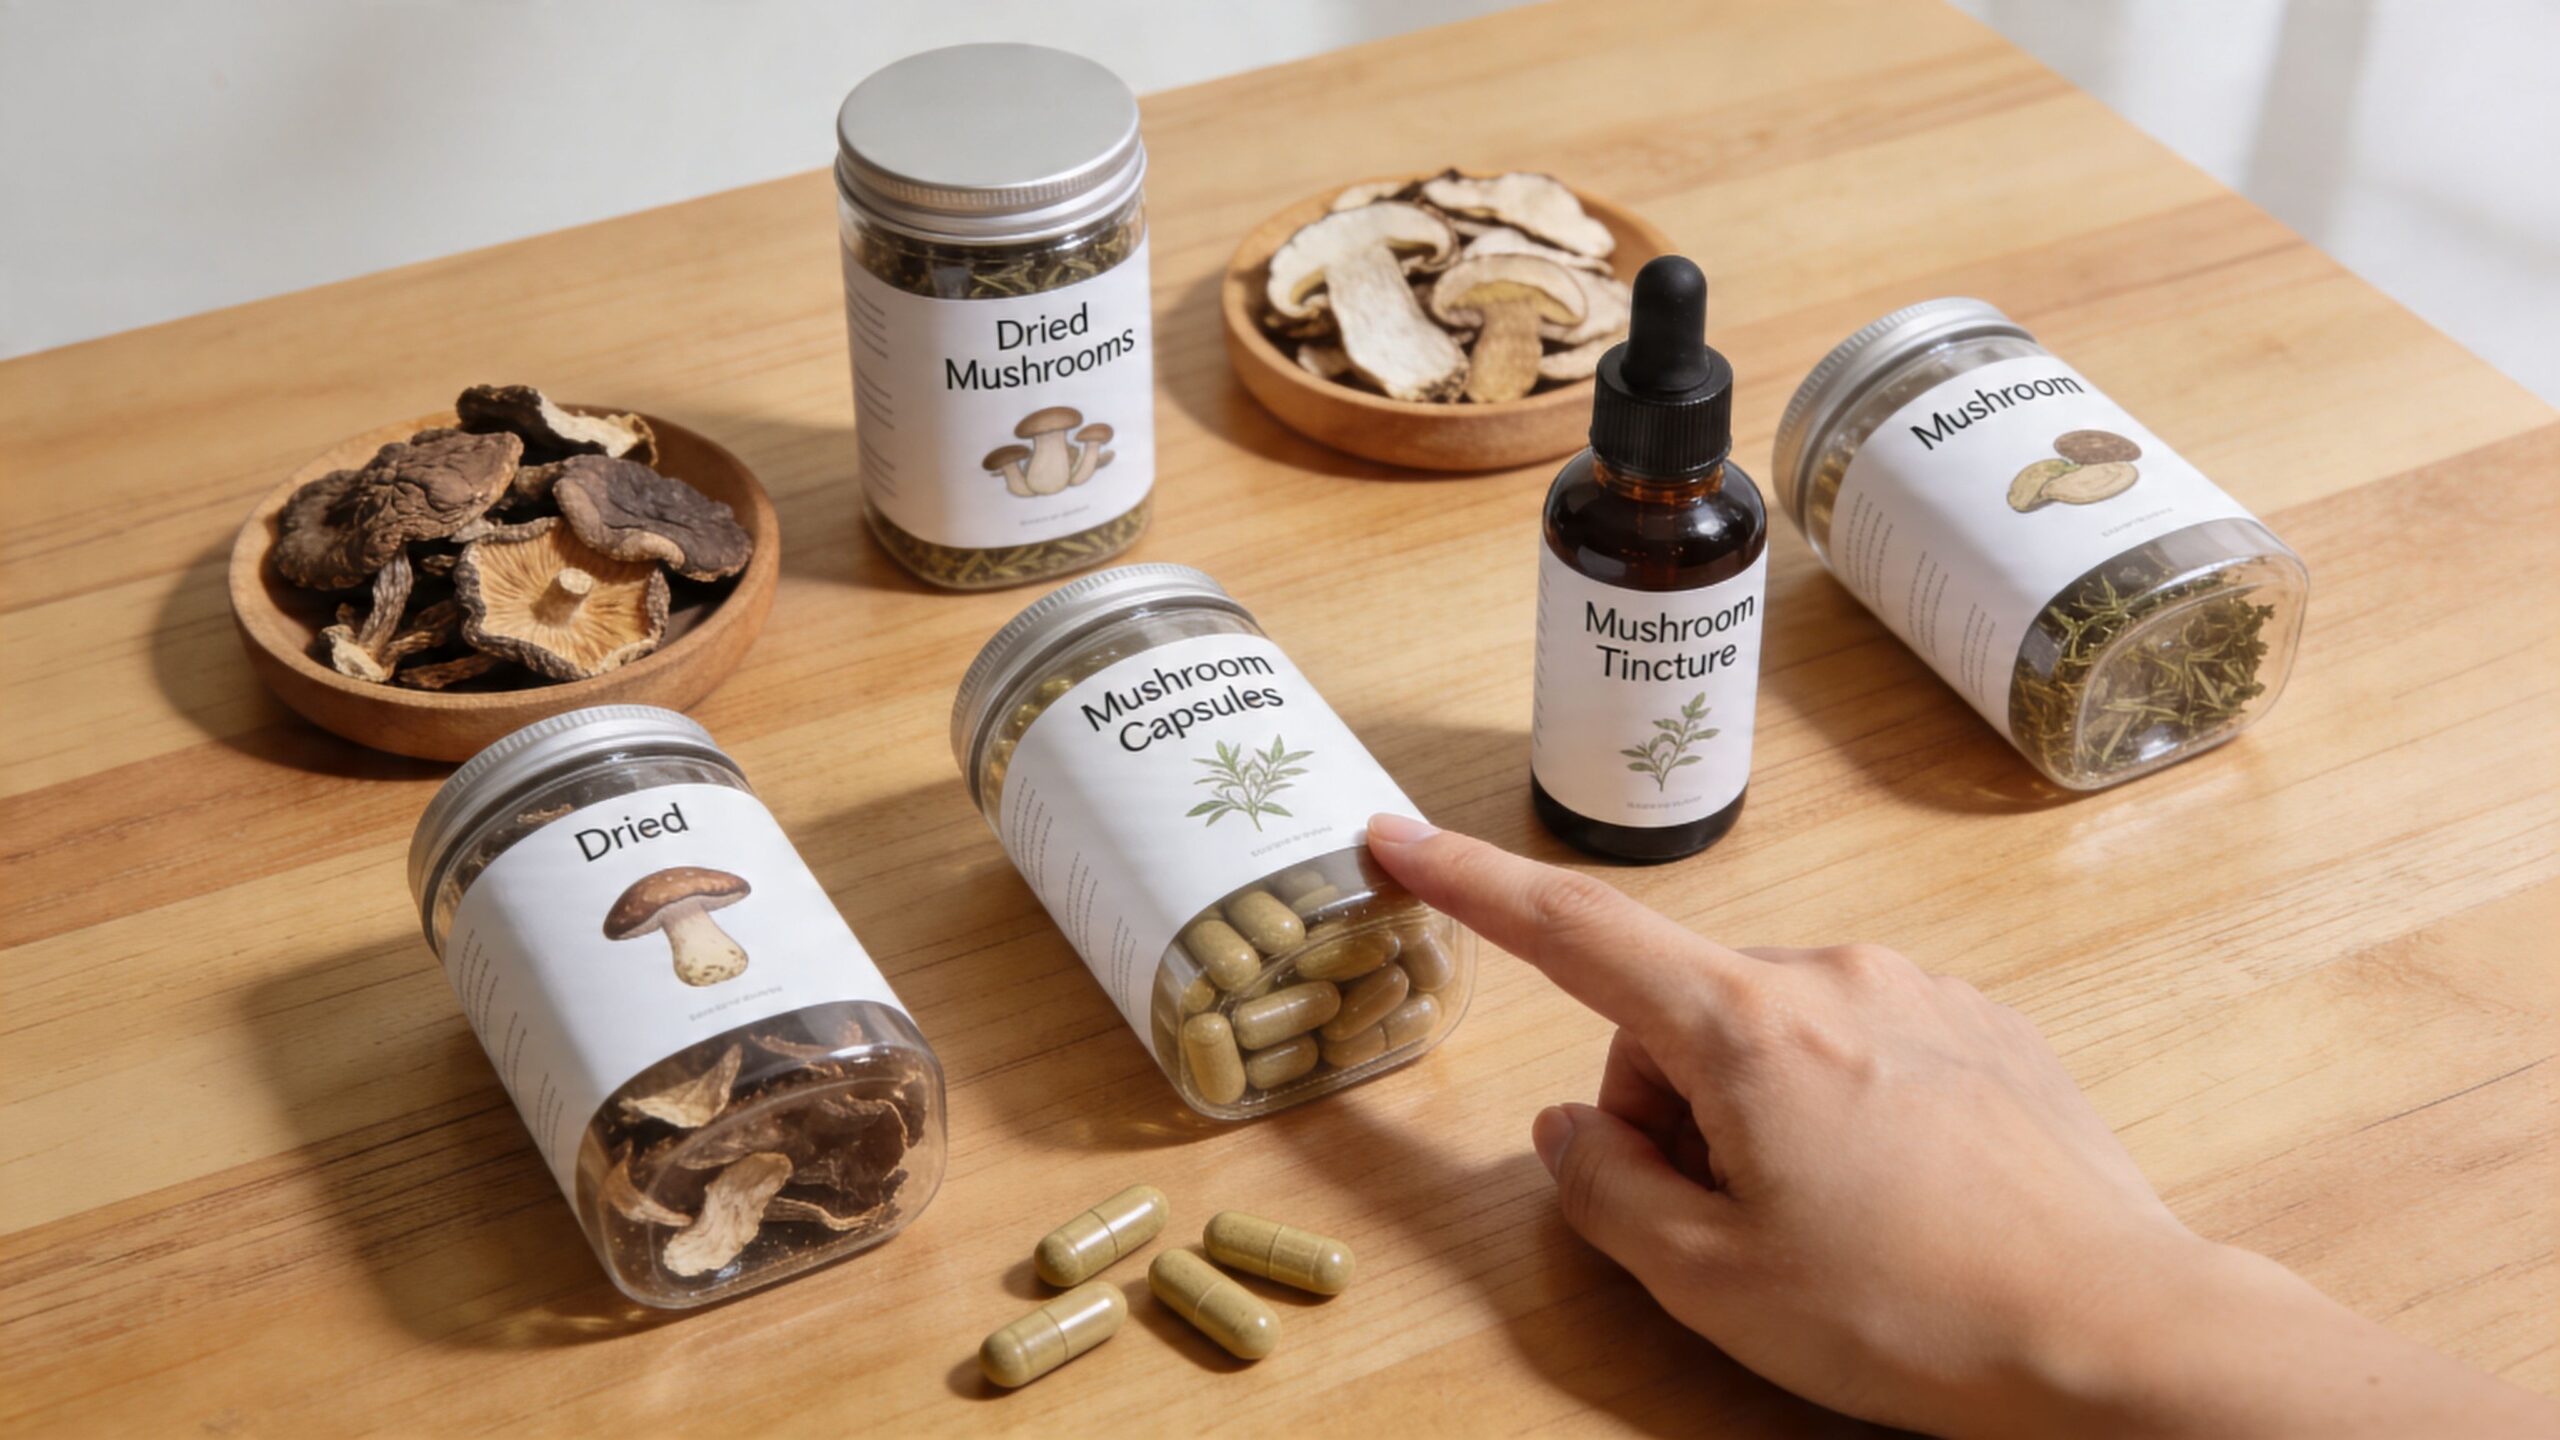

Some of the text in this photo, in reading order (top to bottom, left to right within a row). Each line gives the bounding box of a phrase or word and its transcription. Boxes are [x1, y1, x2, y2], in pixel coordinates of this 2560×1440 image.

[996, 302, 1089, 350] Dried
[945, 329, 1135, 390] Mushrooms
[1910, 373, 2085, 451] Mushroom
[1585, 595, 1755, 643] Mushroom
[1596, 643, 1737, 681] Tincture
[1080, 653, 1274, 733] Mushroom
[1118, 684, 1285, 752] Capsules
[574, 802, 690, 862] Dried
